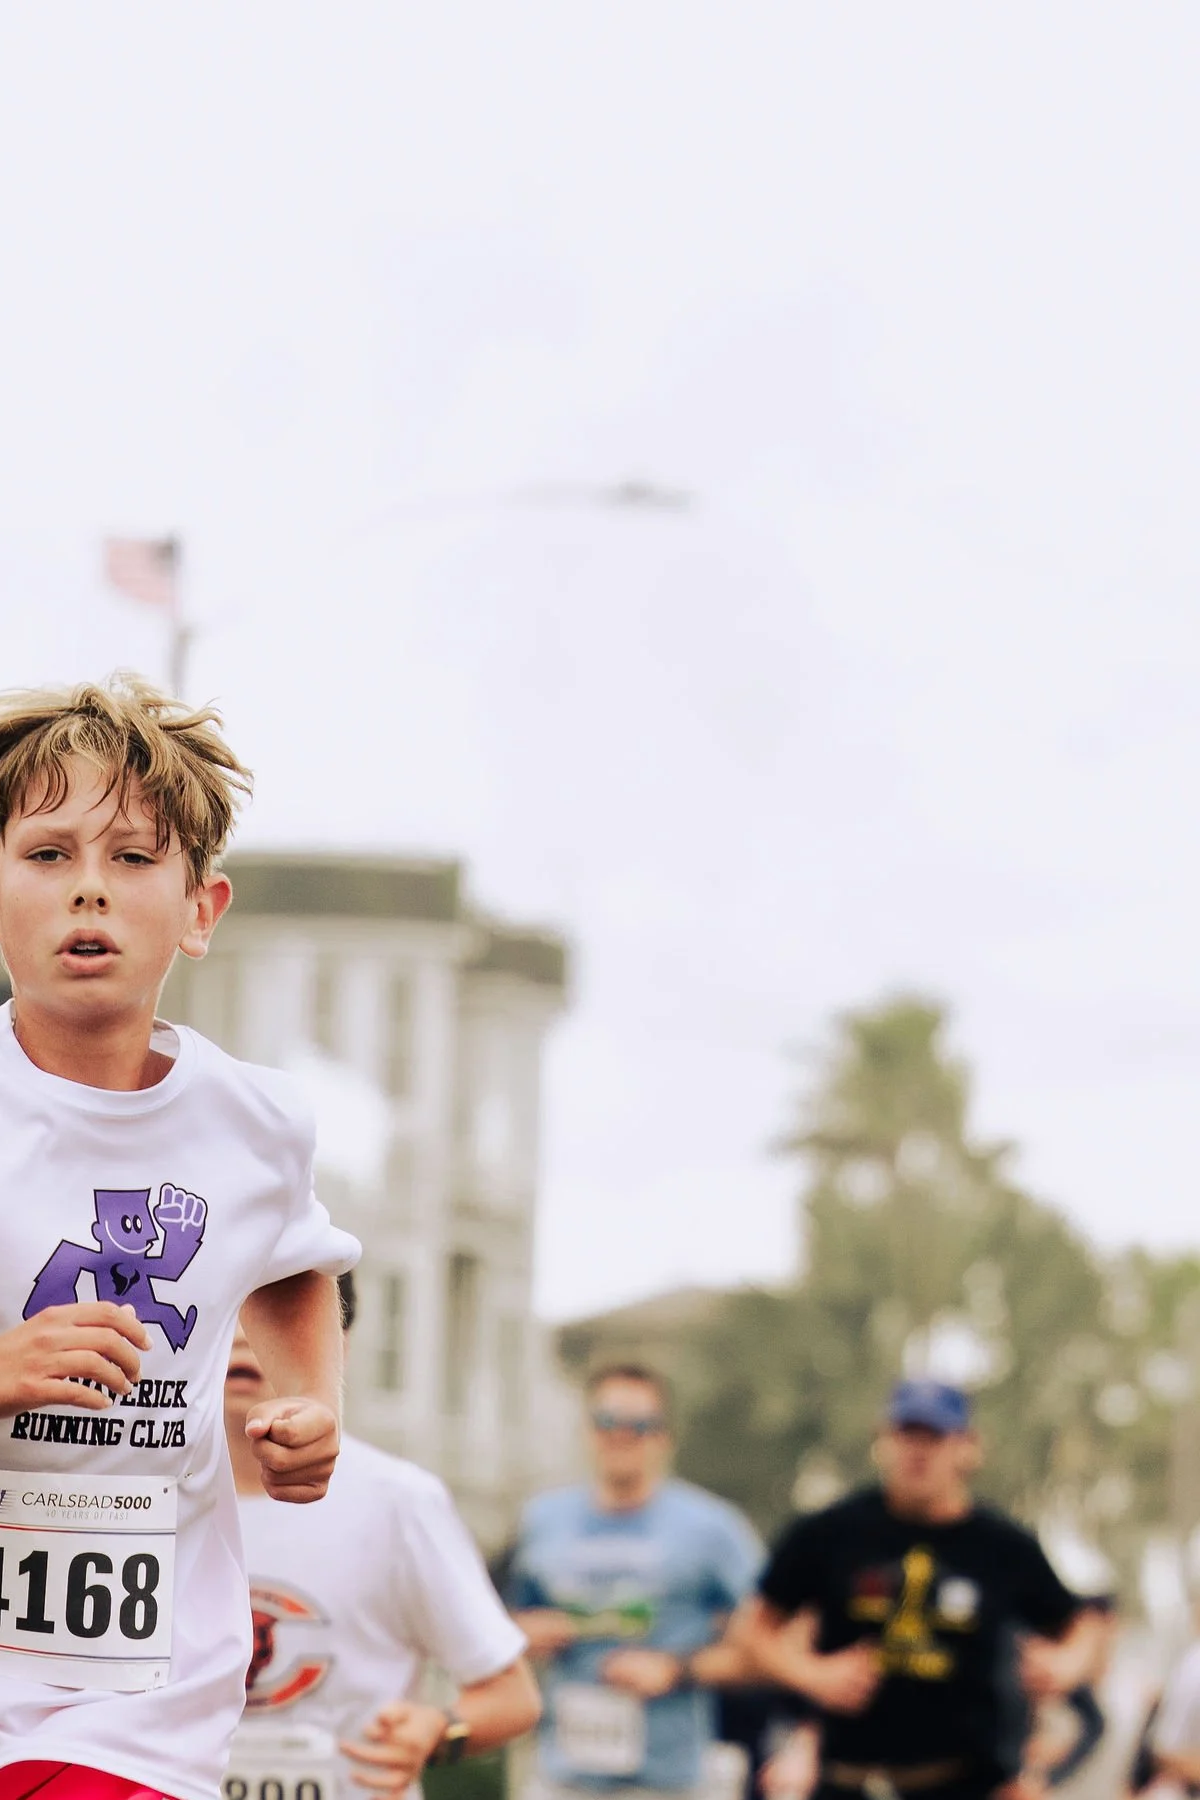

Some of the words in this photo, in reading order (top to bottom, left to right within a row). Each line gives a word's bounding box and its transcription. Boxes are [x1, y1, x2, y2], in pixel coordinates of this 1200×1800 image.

[68, 1377, 188, 1408] ERICK
[10, 1411, 124, 1446] RUNNING
[130, 1419, 187, 1448] CLUB
[21, 1491, 152, 1510] CARLSBAD5000
